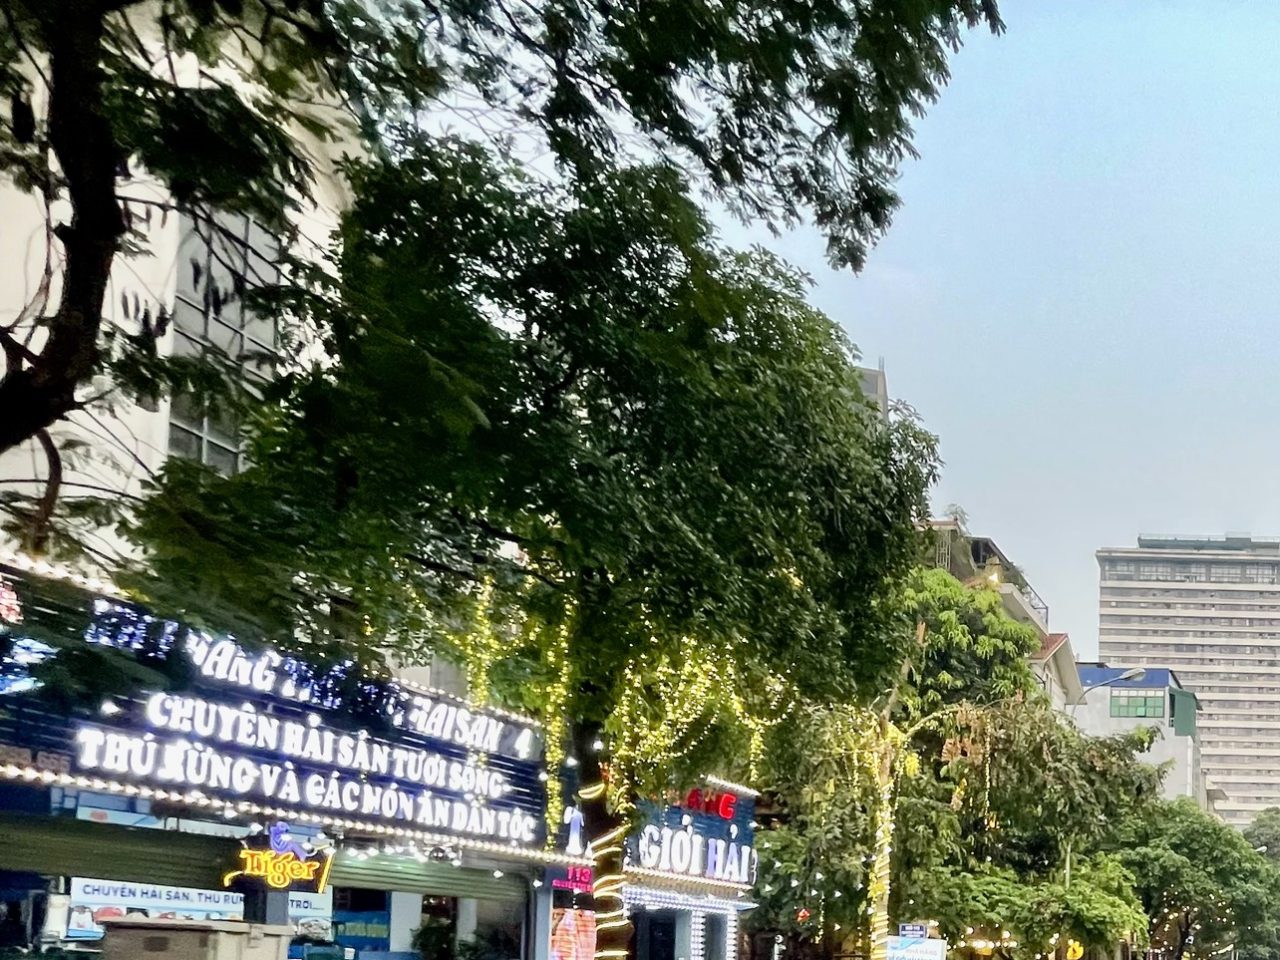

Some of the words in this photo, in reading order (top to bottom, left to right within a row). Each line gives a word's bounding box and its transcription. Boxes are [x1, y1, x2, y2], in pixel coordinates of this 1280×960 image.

[147, 691, 279, 749] CHUYÊN
[284, 713, 334, 762] HẢI
[338, 730, 390, 773] SẢN
[392, 749, 447, 787] TƯƠI
[76, 728, 158, 776] THÚ
[260, 761, 300, 802] VÀ
[306, 770, 360, 811] CÁC
[362, 782, 414, 819] MÓN
[417, 791, 449, 828] ĂN
[452, 800, 497, 838] DÂN
[498, 807, 536, 847] TỘC
[240, 849, 320, 888] Tiger
[566, 866, 592, 883] 113
